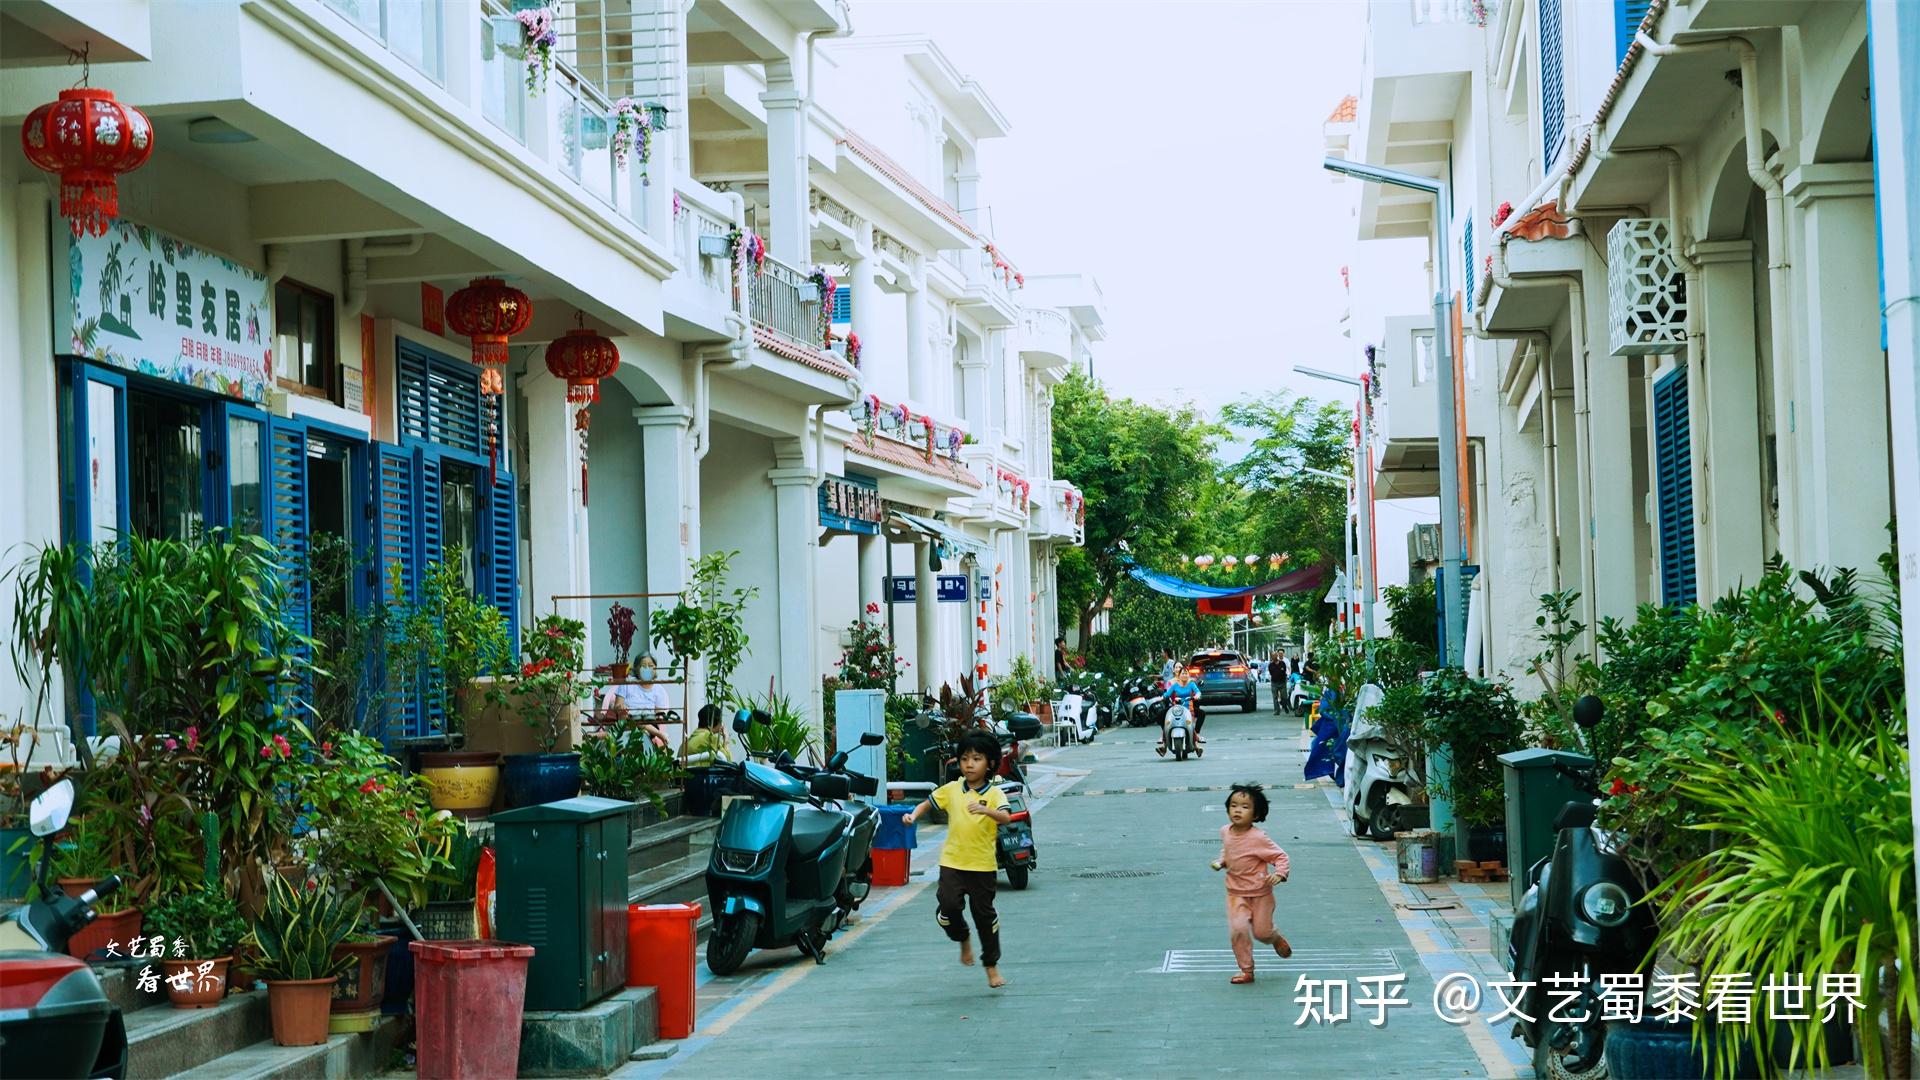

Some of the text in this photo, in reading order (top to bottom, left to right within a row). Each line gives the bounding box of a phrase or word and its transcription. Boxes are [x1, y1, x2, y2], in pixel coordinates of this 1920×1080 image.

[148, 259, 241, 344] 岭里友居
[181, 336, 195, 358] 日租
[196, 341, 208, 362] 月租
